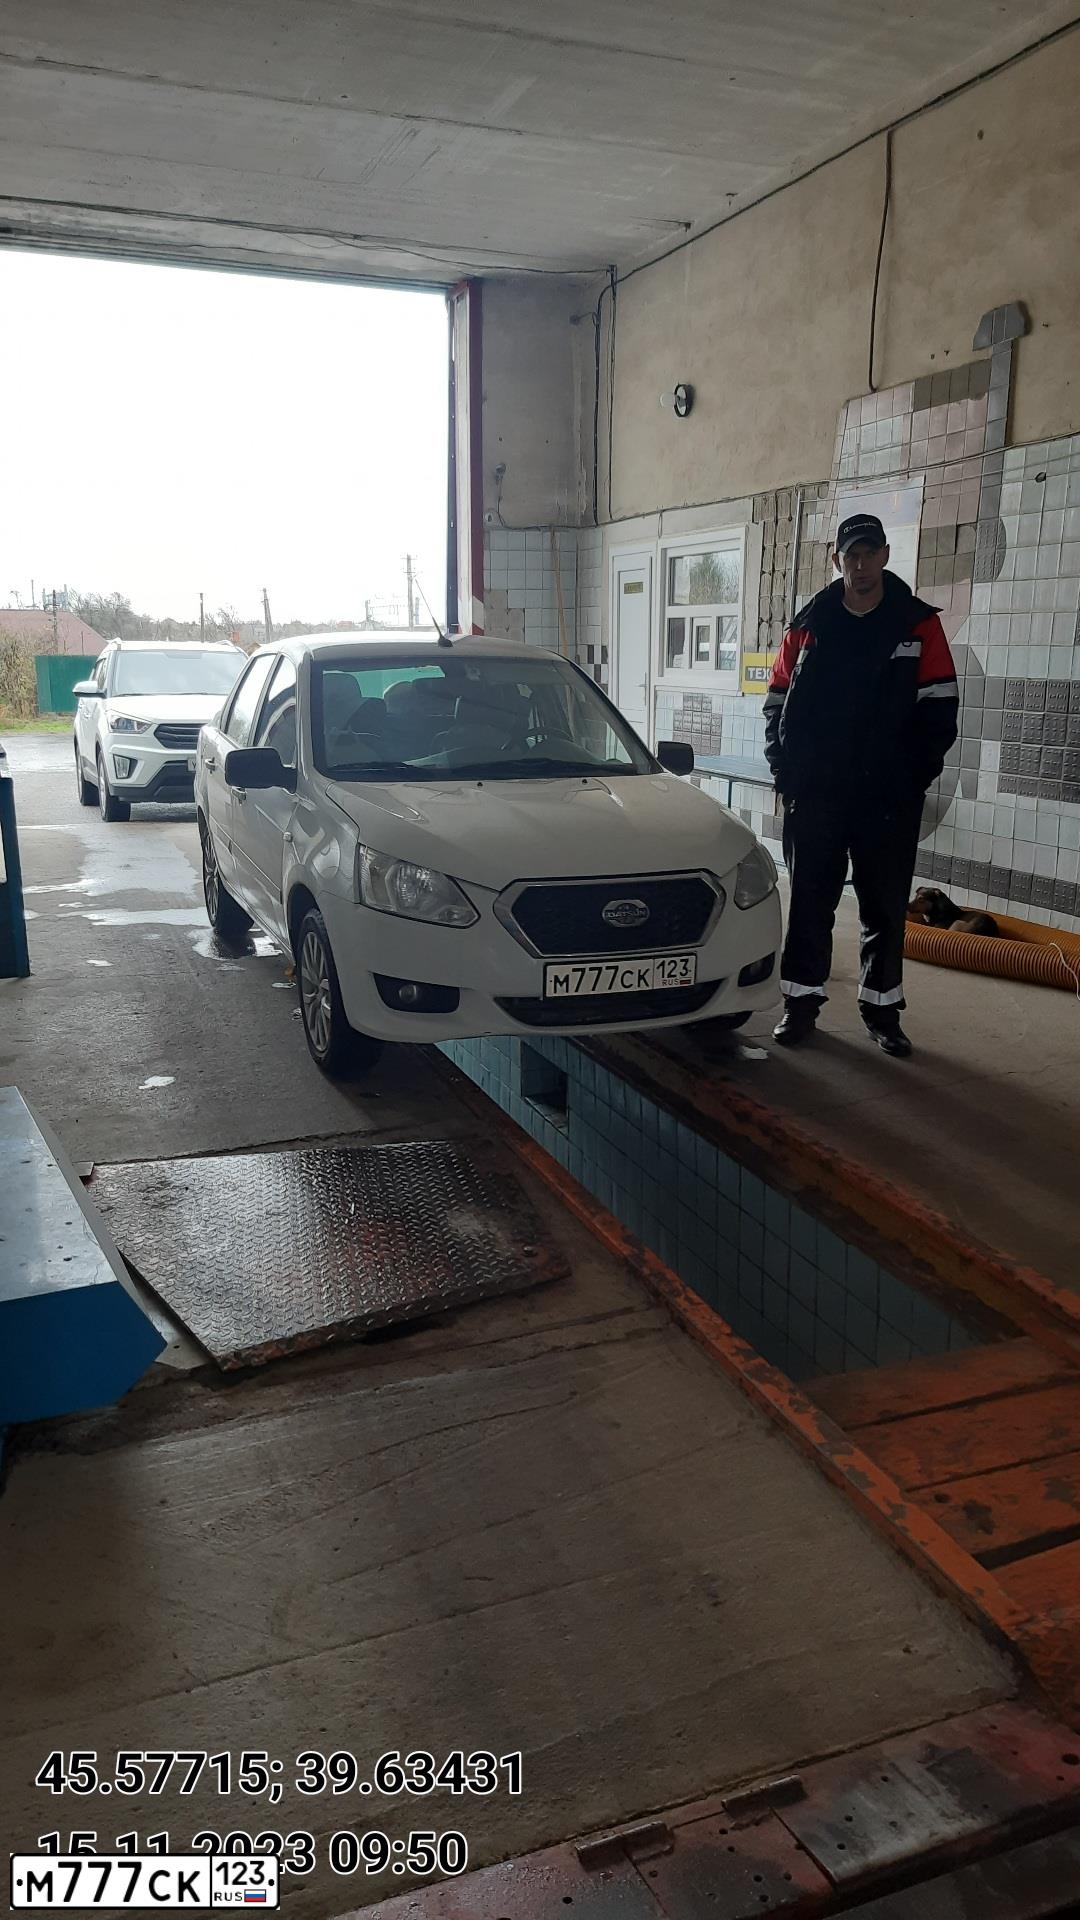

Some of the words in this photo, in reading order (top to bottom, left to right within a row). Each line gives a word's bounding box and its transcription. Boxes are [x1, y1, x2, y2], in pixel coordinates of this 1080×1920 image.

[553, 965, 650, 994] М777СК
[656, 958, 690, 978] 123
[662, 978, 680, 986] RUS
